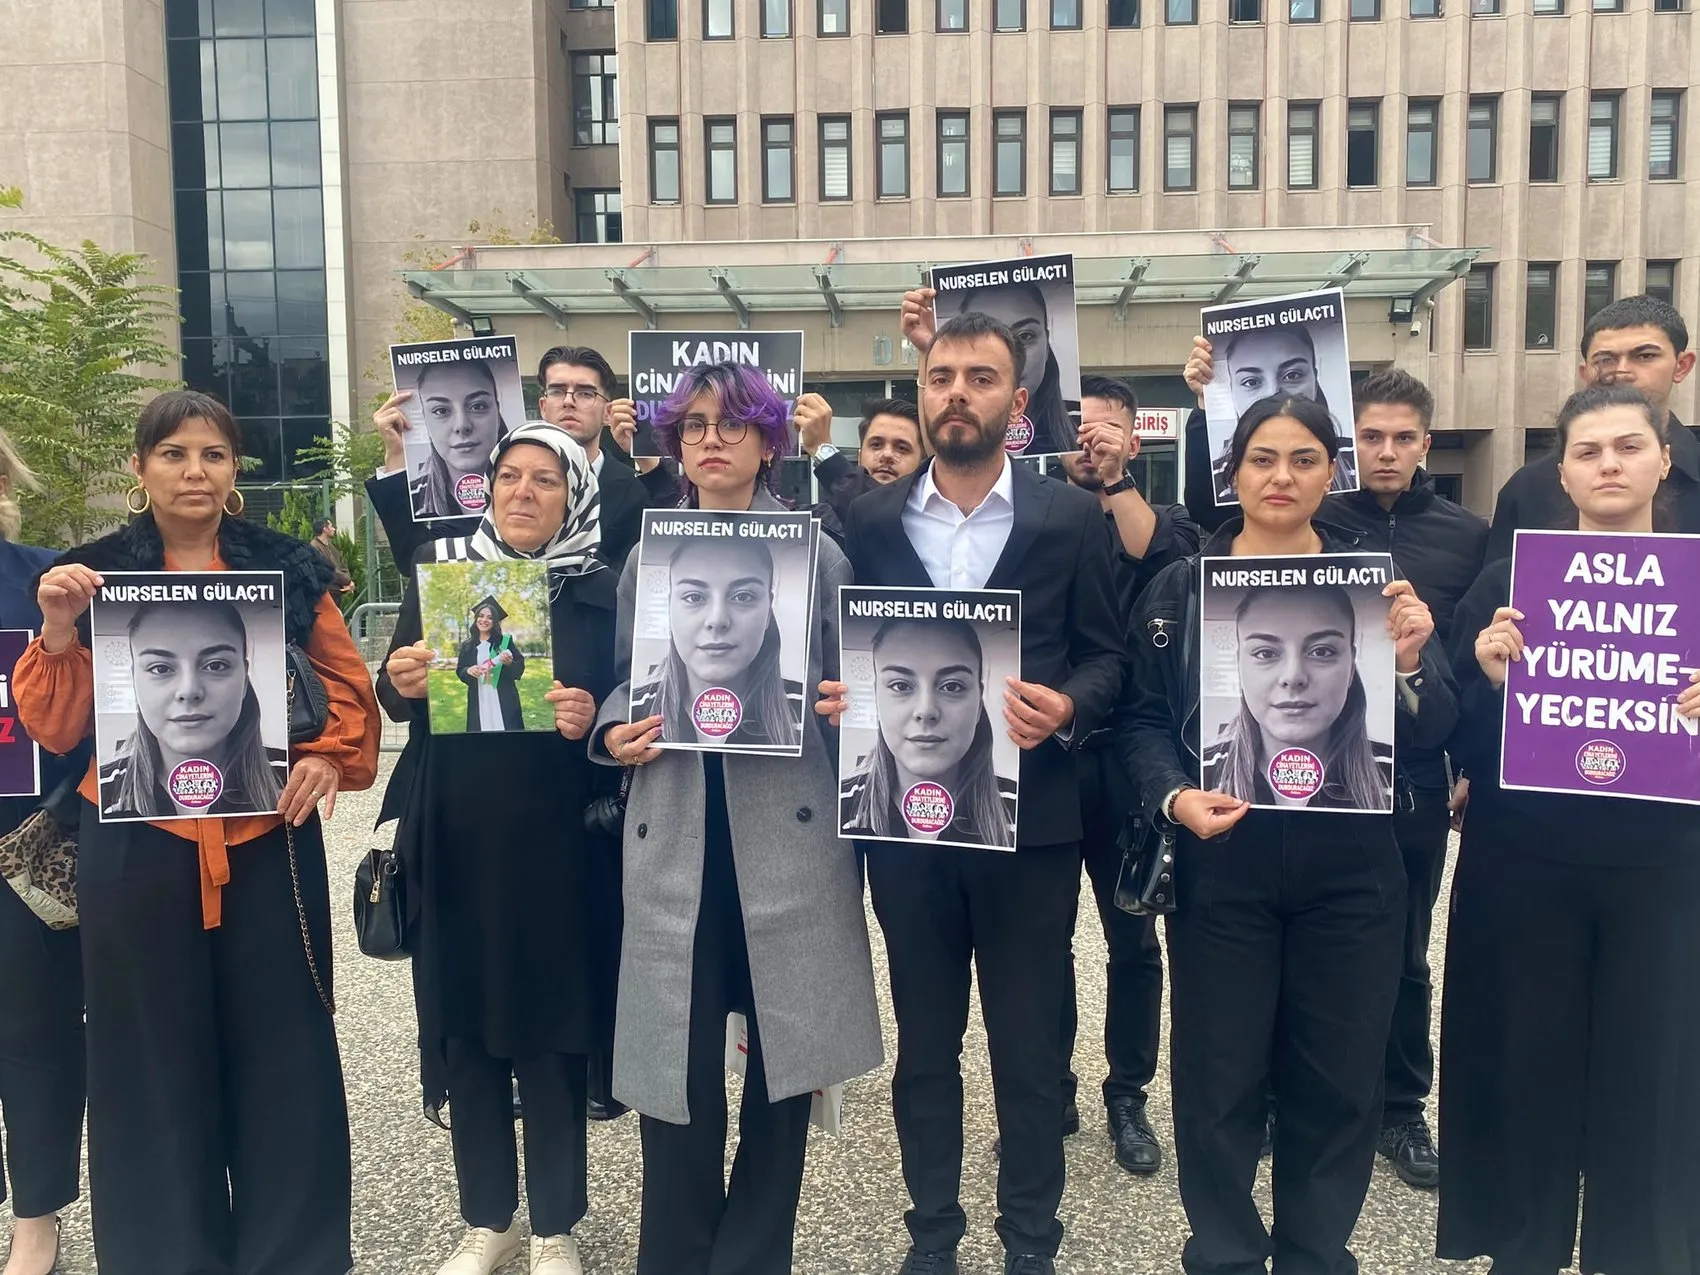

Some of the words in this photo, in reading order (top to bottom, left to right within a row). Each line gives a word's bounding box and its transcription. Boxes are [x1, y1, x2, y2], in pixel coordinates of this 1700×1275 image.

[939, 270, 1009, 291] NURSELEN
[1012, 264, 1067, 281] GÜLAÇTI
[1207, 313, 1276, 335] NURSELEN
[1279, 304, 1335, 324] GÜLAÇTI
[396, 349, 460, 365] NURSELEN
[462, 345, 512, 360] GÜLAÇTI
[672, 340, 760, 367] KADIN
[1133, 412, 1169, 434] GİRİŞ
[651, 521, 733, 538] NURSELEN
[739, 519, 803, 540] GÜLAÇTI
[1212, 568, 1307, 587] NURSELEN
[1313, 565, 1387, 586] GÜLAÇTI
[1563, 552, 1665, 587] ASLA
[101, 585, 197, 602] NURSELEN
[203, 582, 274, 603] GÜLAÇTI
[849, 601, 937, 619] NURSELEN
[942, 600, 1012, 623] GÜLAÇTI
[1547, 599, 1679, 637] YALNIZ
[1522, 641, 1700, 686] YÜRÜME-
[704, 694, 731, 702] KADIN
[1515, 692, 1699, 736] YECEKSİN
[1281, 754, 1311, 763] KADIN
[1588, 745, 1614, 753] KADIN
[914, 788, 942, 797] KADIN
